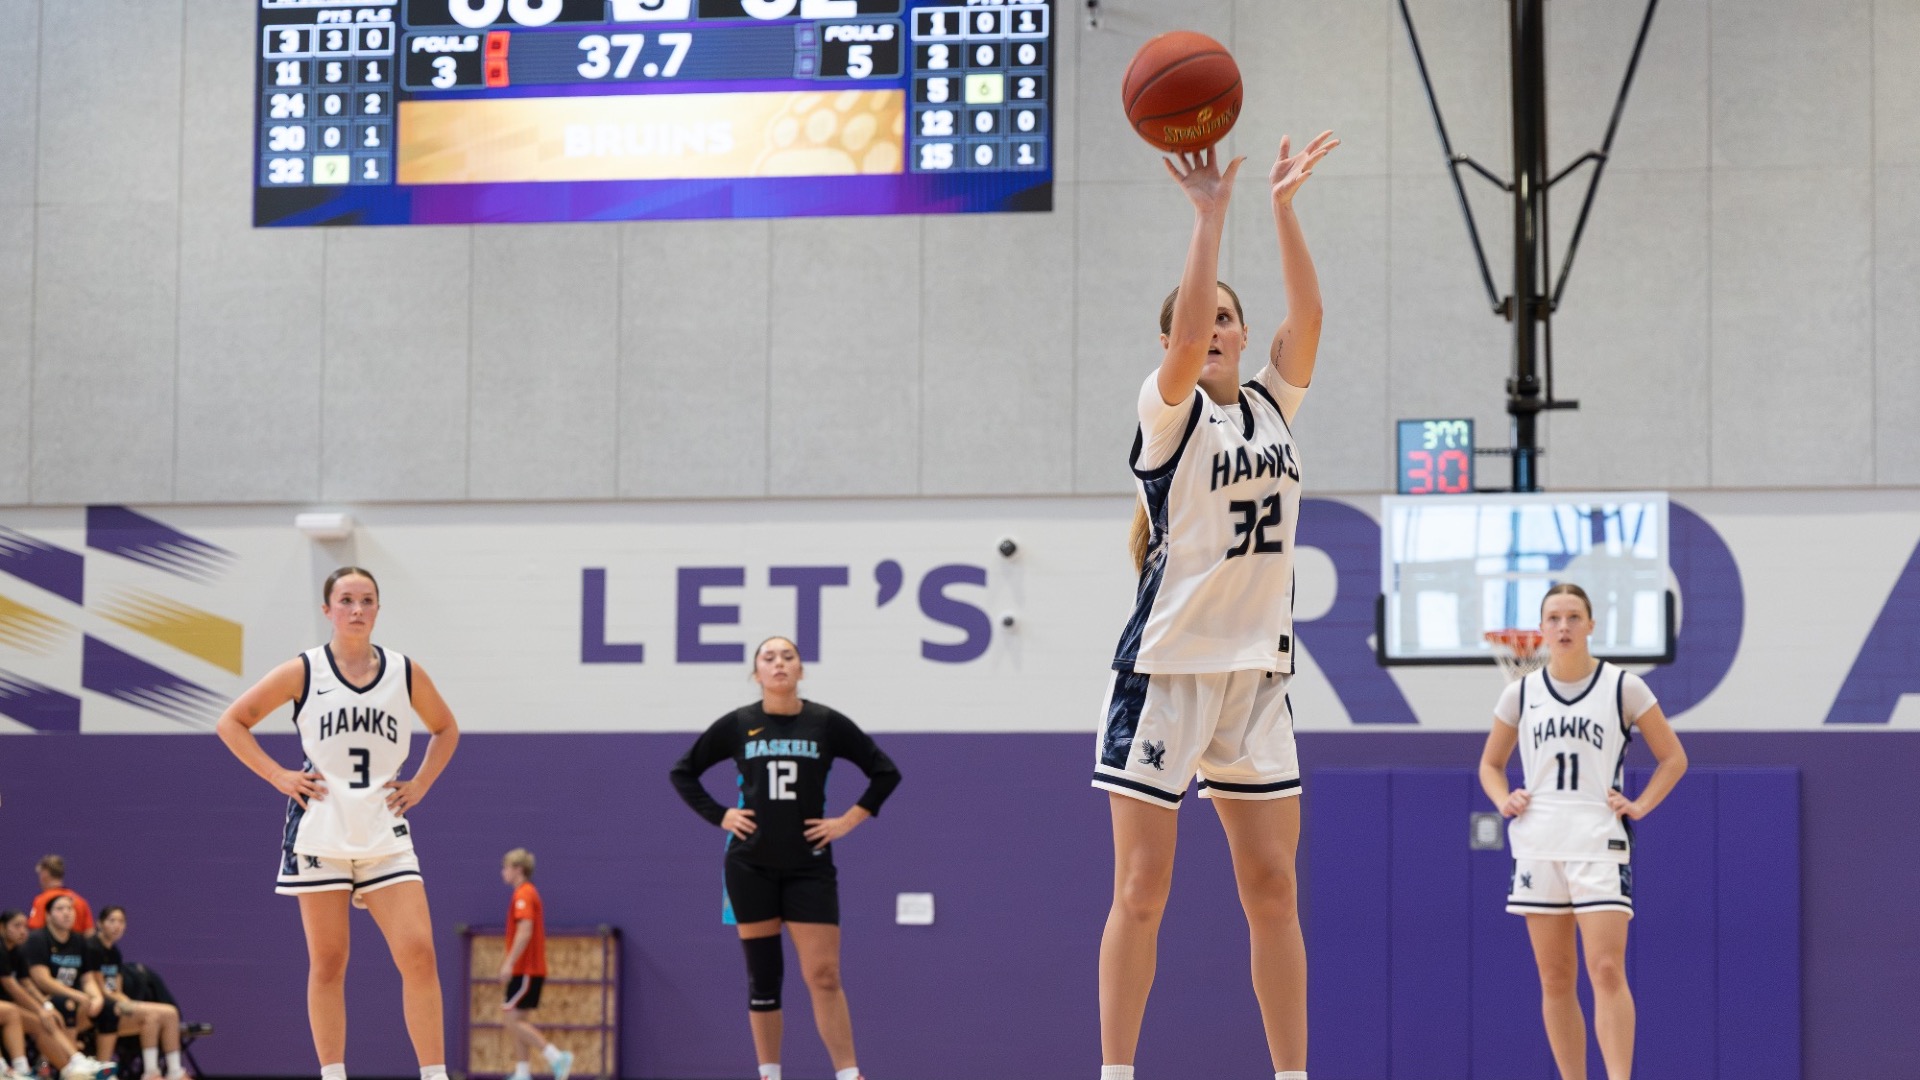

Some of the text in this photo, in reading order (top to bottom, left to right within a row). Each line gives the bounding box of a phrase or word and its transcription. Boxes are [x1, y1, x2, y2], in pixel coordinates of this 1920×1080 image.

[824, 24, 894, 42] FOULS
[930, 11, 1036, 36] 1 0 1
[279, 29, 382, 52] 3 3 0
[411, 35, 479, 53] FOULS
[577, 33, 692, 79] 37.7
[847, 45, 873, 79] 5
[928, 44, 1036, 69] 2 0 0
[276, 60, 381, 86] 11 5 1
[431, 56, 457, 89] 3
[927, 77, 949, 103] 5
[1017, 77, 1035, 99] 2
[270, 93, 381, 118] 24 0 2
[921, 110, 1035, 136] 12 0 0
[269, 126, 380, 152] 30 0 1
[564, 121, 734, 158] BRUINS
[269, 158, 304, 183] 32
[363, 158, 379, 179] 1
[921, 143, 1035, 169] 15 0 1
[1210, 444, 1299, 492] HAWKS
[1408, 450, 1469, 494] 30
[1225, 492, 1283, 560] 32
[581, 559, 992, 664] LET'S
[320, 707, 398, 744] HAWKS
[1533, 716, 1604, 750] HAWKS
[745, 739, 820, 760] HASKELL
[348, 748, 370, 789] 3
[766, 760, 798, 800] 12
[1555, 752, 1579, 790] 11
